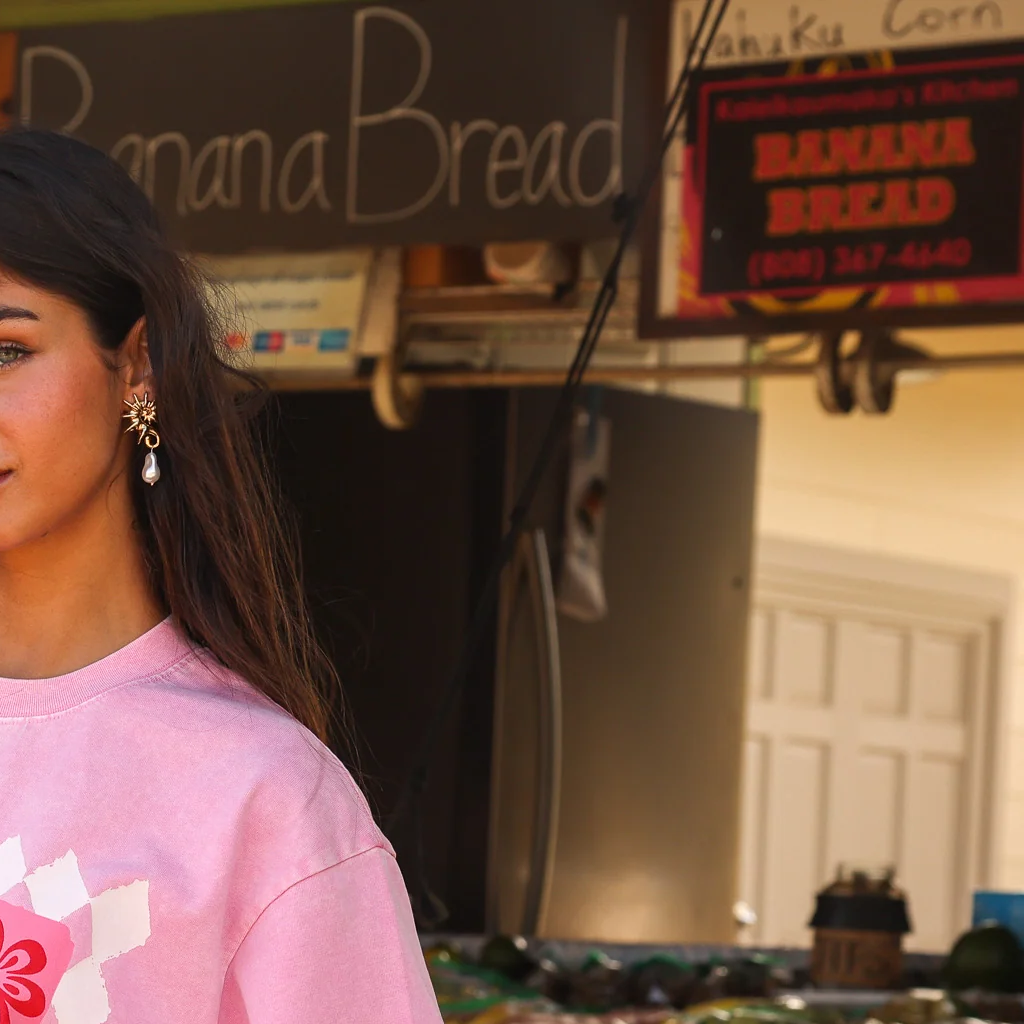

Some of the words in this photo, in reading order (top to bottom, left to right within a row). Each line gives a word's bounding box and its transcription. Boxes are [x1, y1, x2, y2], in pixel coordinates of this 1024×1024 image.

[880, 0, 1003, 39] Corn
[346, 6, 628, 223] Bread
[753, 116, 975, 181] BANANA
[765, 176, 956, 237] BREAD
